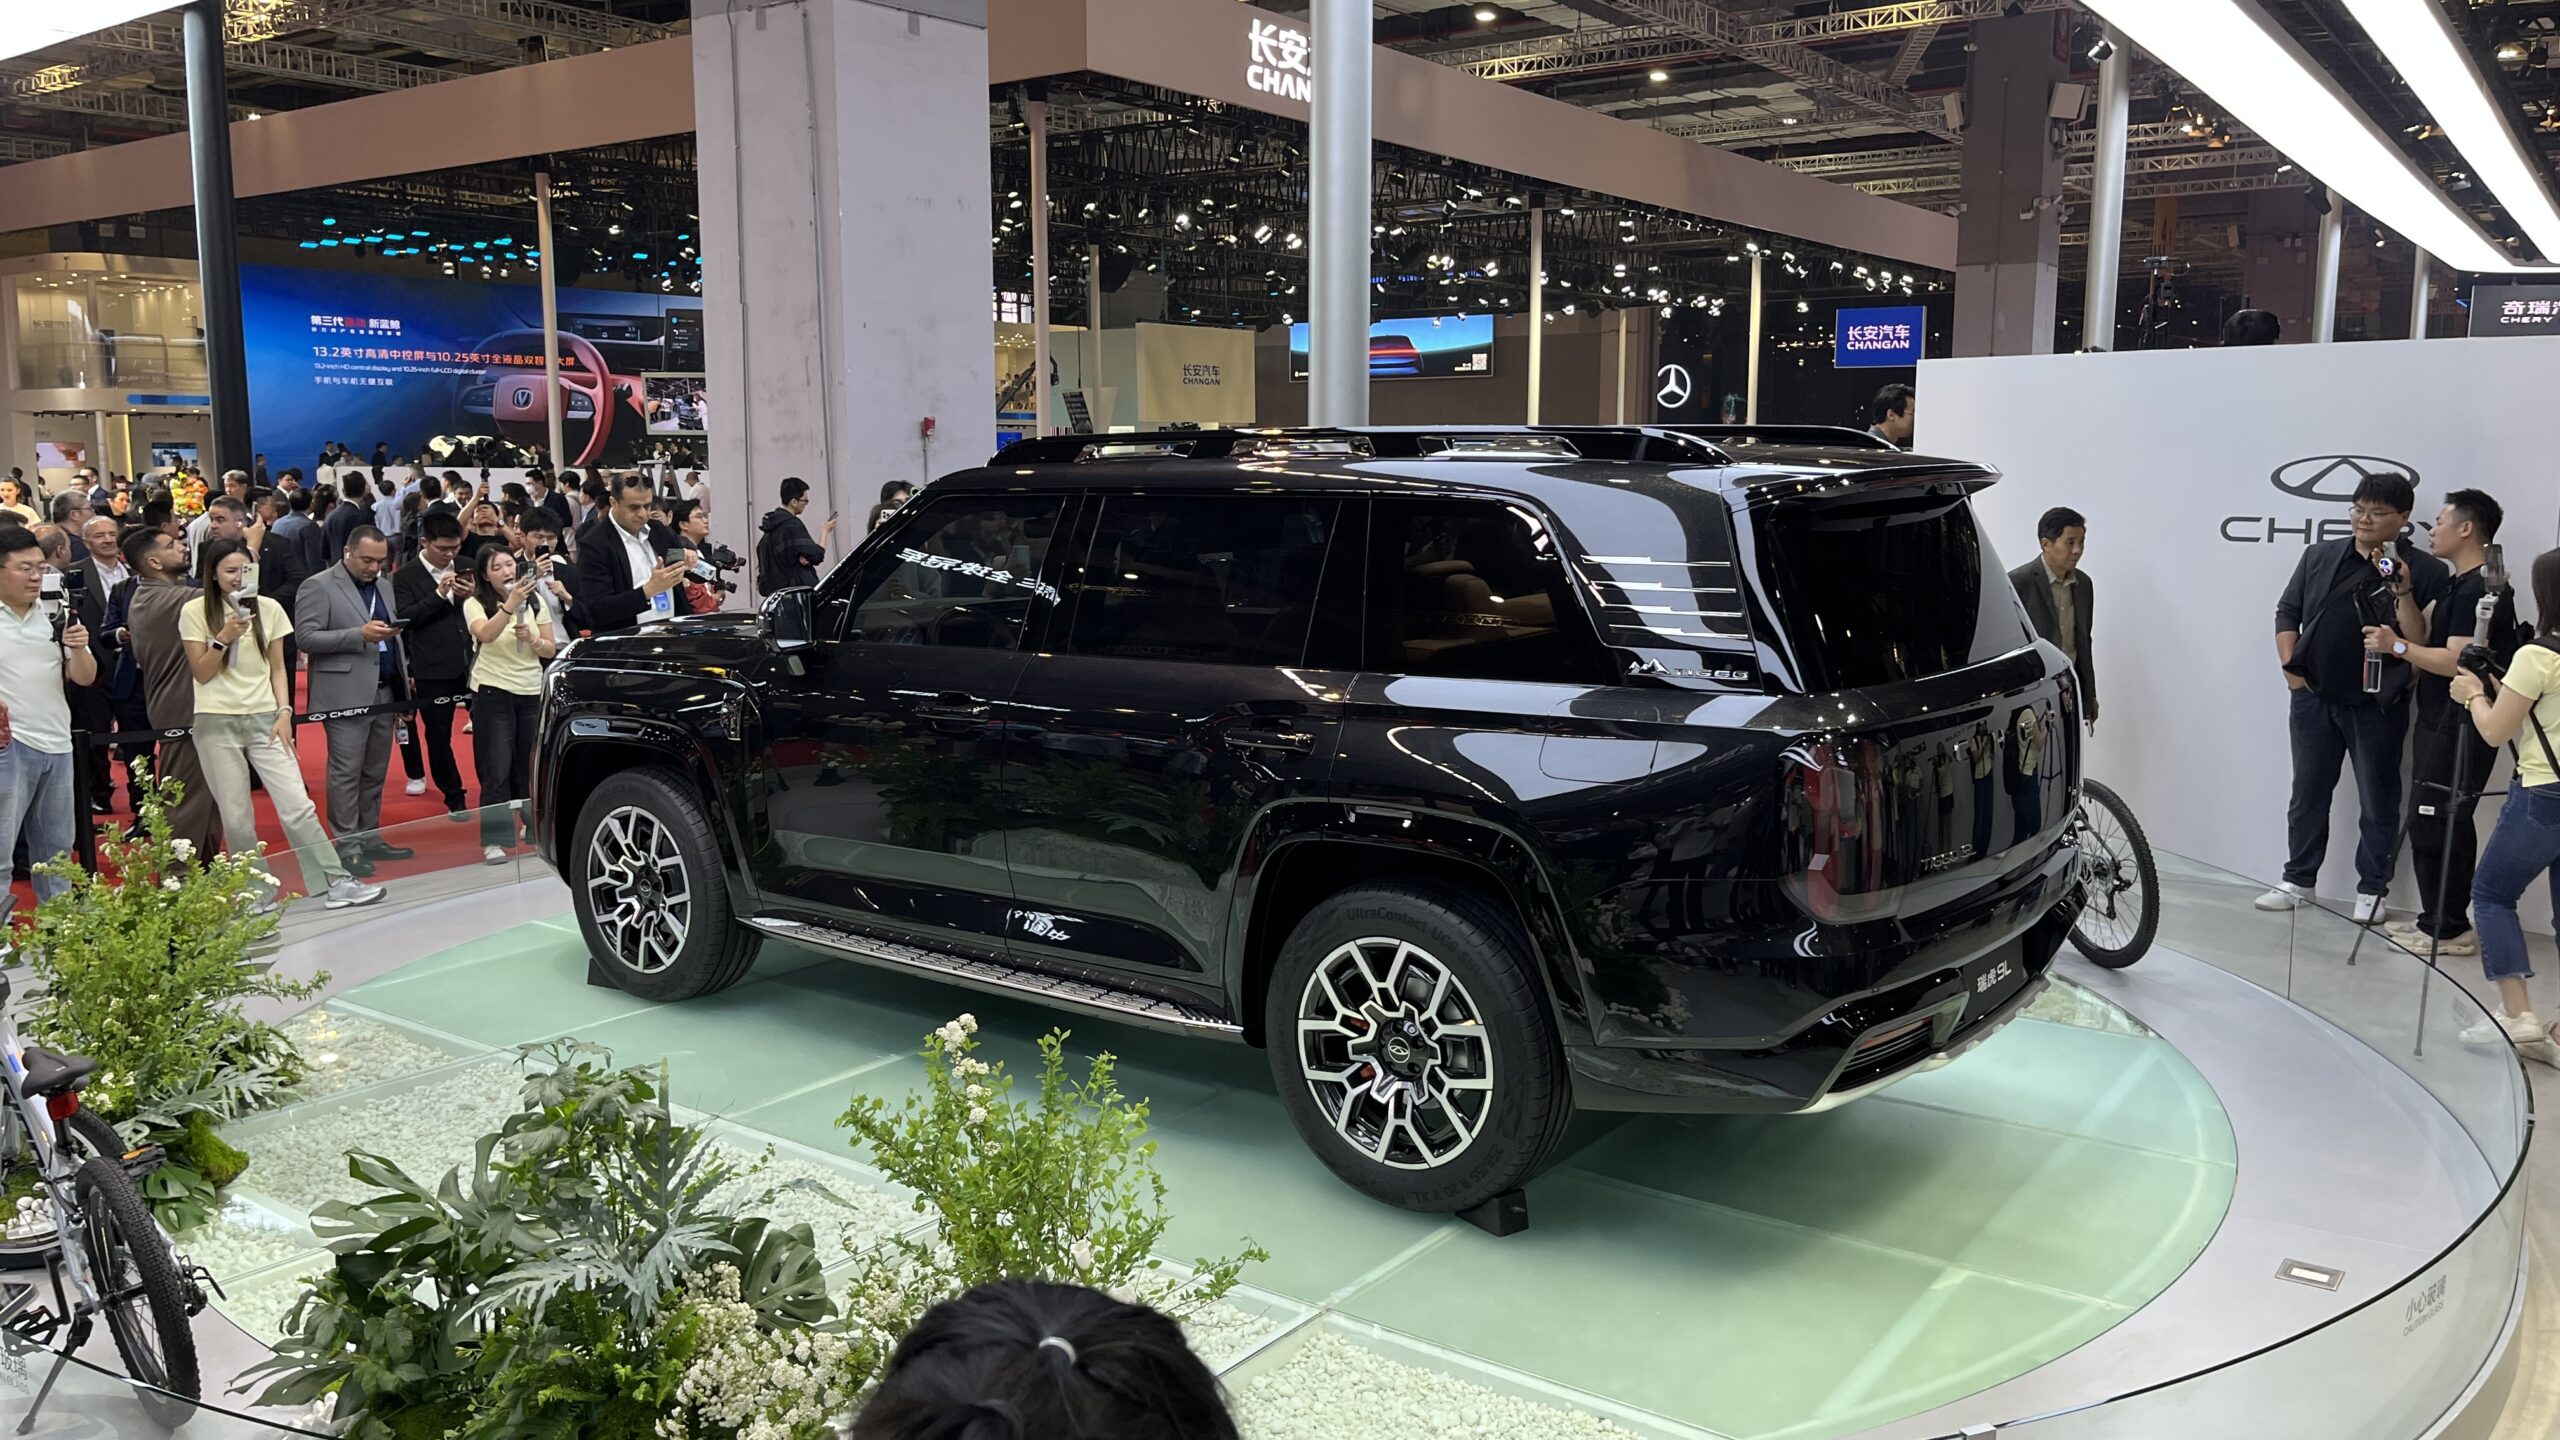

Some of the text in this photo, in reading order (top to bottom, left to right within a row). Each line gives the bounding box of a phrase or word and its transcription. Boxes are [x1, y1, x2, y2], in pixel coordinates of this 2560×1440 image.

[1248, 18, 1312, 76] 长安
[1246, 64, 1312, 103] CHAN
[2500, 316, 2553, 324] CHERY
[1847, 324, 1910, 340] 长安汽车
[1846, 340, 1910, 350] CHANGAN
[1183, 364, 1220, 377] 长安汽车
[1183, 377, 1220, 385] CHANGAN
[330, 707, 369, 719] CHERY
[1347, 906, 1428, 933] UltraContact
[2405, 1274, 2447, 1322] 小心玻璃
